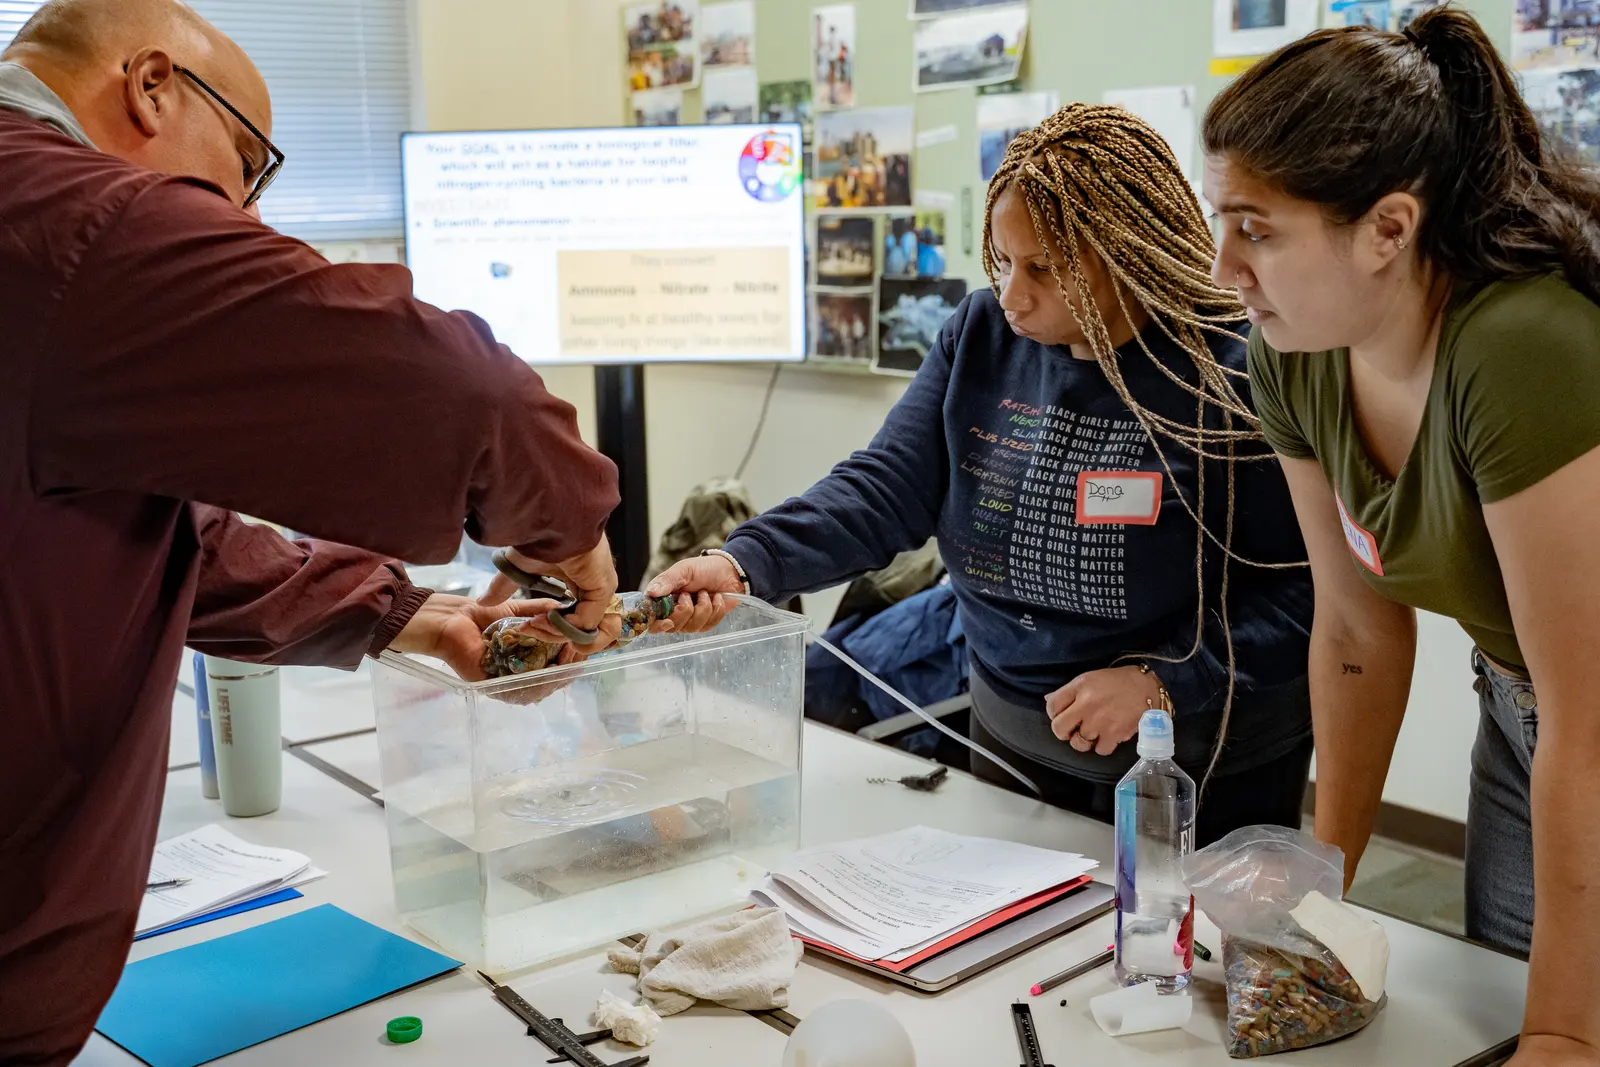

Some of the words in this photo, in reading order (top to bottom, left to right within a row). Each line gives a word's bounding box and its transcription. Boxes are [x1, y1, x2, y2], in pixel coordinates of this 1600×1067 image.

[1046, 405, 1077, 422] BLACK
[1080, 416, 1109, 428] GIRLS
[1038, 430, 1069, 446] BLACK
[1071, 439, 1101, 452] GIRLS
[1104, 443, 1145, 456] MATTER
[1042, 418, 1073, 433] BLACK
[1076, 427, 1105, 440] GIRLS
[1108, 432, 1149, 443] MATTER
[969, 427, 999, 443] PLUS
[1000, 437, 1034, 451] SIZED
[1034, 443, 1065, 458] BLACK
[1067, 451, 1097, 463] GIRLS
[1099, 455, 1141, 467] MATTER
[1025, 468, 1056, 483] BLACK
[1030, 455, 1060, 470] BLACK
[960, 461, 1019, 487] LIGHTSKIN
[1022, 480, 1052, 495] BLACK
[1055, 488, 1077, 500] GIRL
[978, 484, 1015, 499] MIXED
[1019, 494, 1049, 509] BLACK
[1052, 500, 1075, 513] GIRL
[979, 496, 1012, 512] LOUD
[1017, 507, 1047, 522] BLACK
[1051, 514, 1079, 528] GIRLS
[1011, 533, 1042, 548] BLACK
[1047, 540, 1076, 554] GIRLS
[1081, 546, 1124, 558] MATTER
[1048, 527, 1078, 541] GIRLS
[1082, 533, 1125, 544] MATTER
[1010, 545, 1041, 560] BLACK
[1045, 553, 1075, 568] GIRLS
[1080, 560, 1124, 571] MATTER
[1009, 558, 1041, 573] BLACK
[1045, 566, 1075, 580] GIRLS
[1080, 573, 1124, 585] MATTER
[1010, 568, 1042, 583] BLACK
[1046, 577, 1076, 591] GIRLS
[1081, 585, 1125, 597] MATTER
[1011, 579, 1044, 593] BLACK
[1048, 588, 1078, 600] GIRLS
[1083, 595, 1126, 607] MATTER
[1013, 588, 1046, 602] BLACK
[1050, 597, 1080, 609] GIRLS
[1084, 604, 1127, 615] MATTER
[1341, 661, 1363, 675] yes
